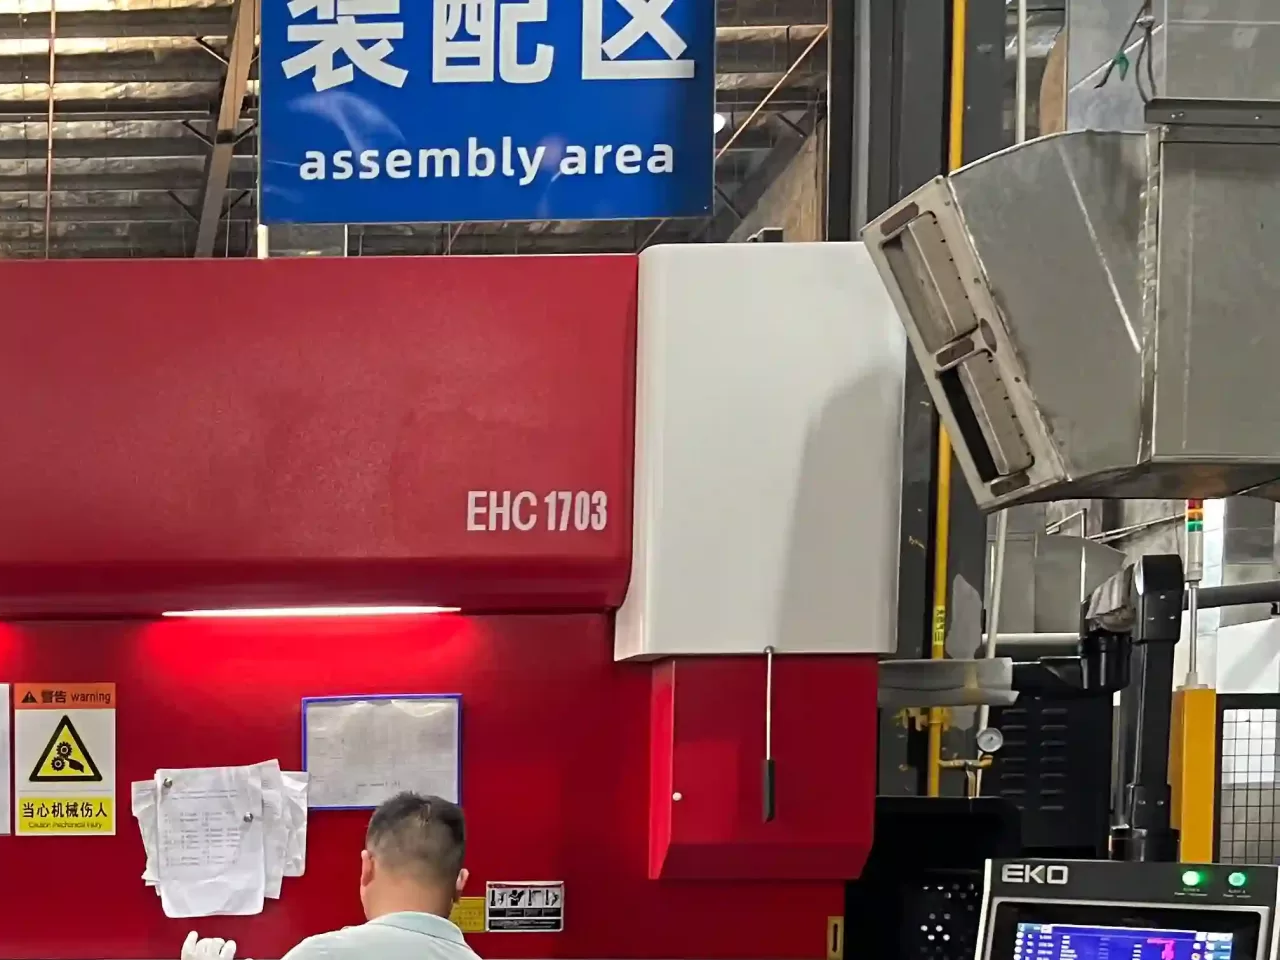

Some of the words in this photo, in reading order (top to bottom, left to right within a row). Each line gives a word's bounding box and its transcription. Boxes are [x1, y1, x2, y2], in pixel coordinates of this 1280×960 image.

[281, 0, 695, 92] 装配区
[299, 136, 545, 185] assembly
[558, 142, 674, 174] area
[467, 491, 537, 531] EHC
[544, 491, 607, 531] 1703
[71, 690, 111, 704] warning
[23, 802, 108, 818] 当心机械伤人
[1002, 864, 1068, 884] EKO
